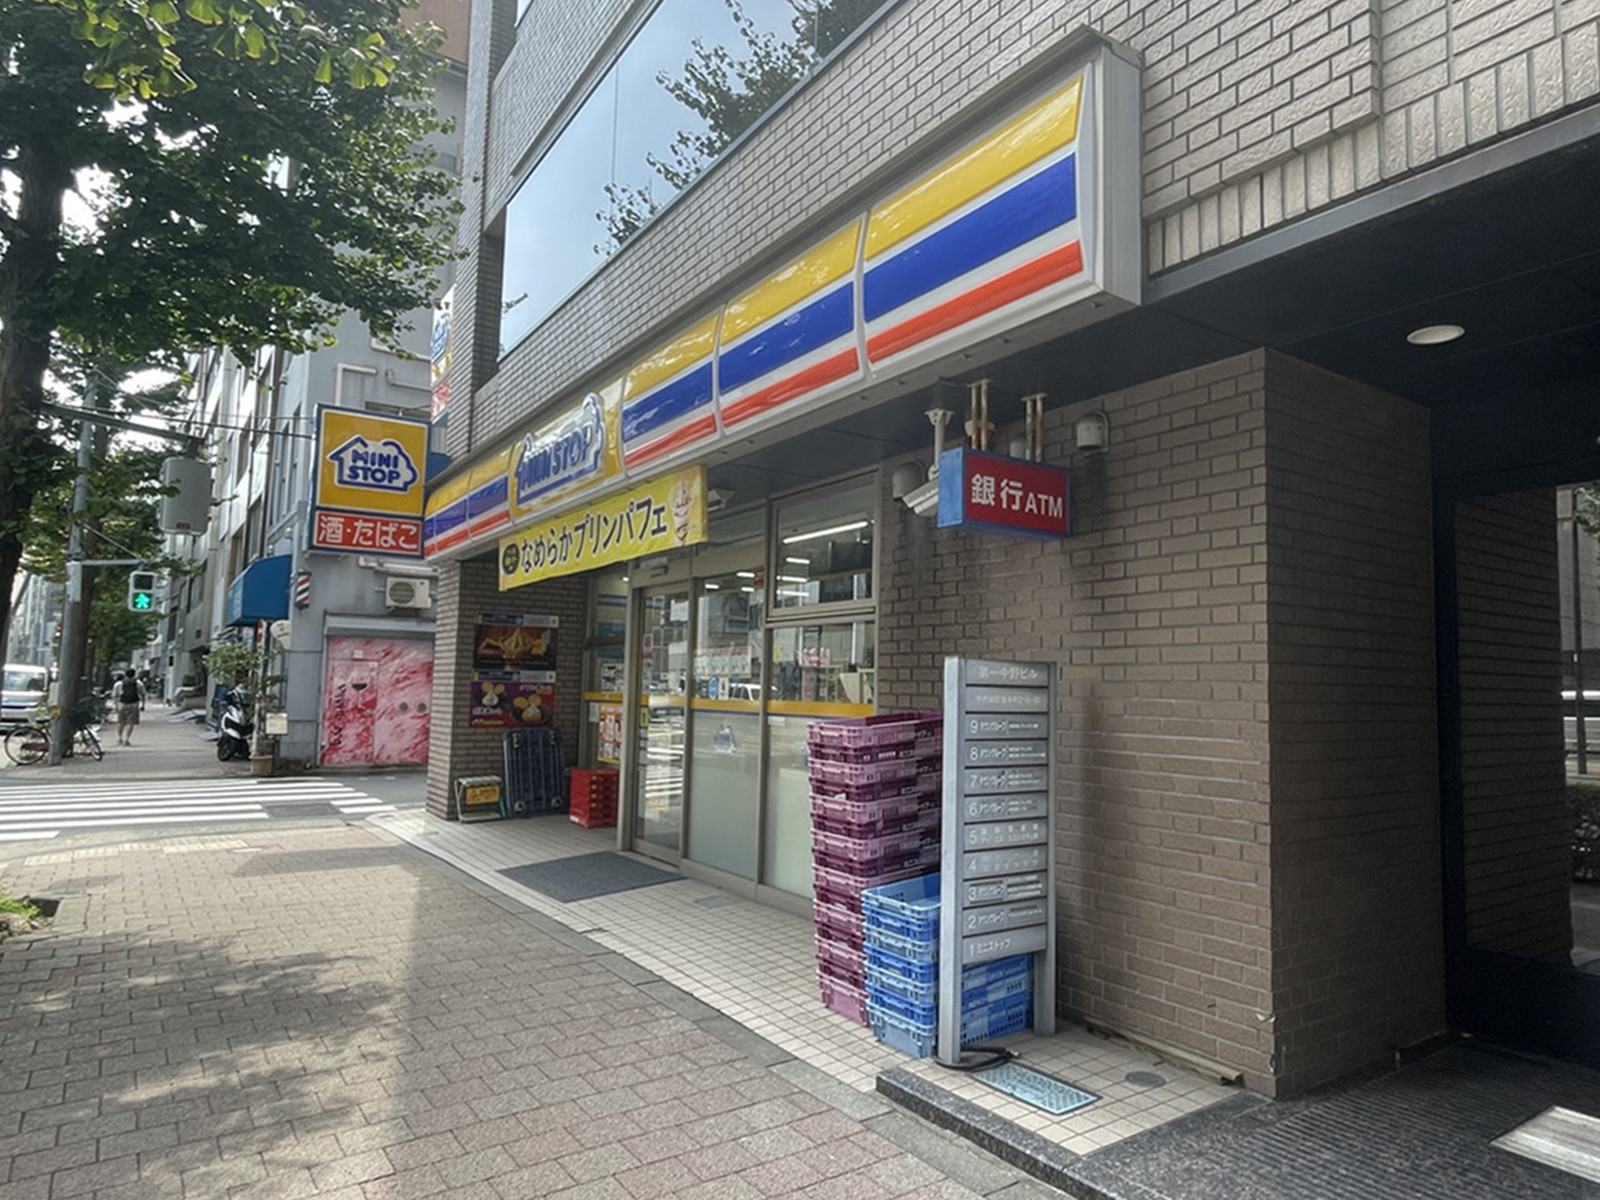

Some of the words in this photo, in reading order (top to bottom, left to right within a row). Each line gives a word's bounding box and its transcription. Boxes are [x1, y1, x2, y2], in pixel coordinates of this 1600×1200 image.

[551, 425, 593, 476] STOP
[351, 449, 399, 469] MINI
[347, 466, 401, 485] STOP
[970, 473, 1063, 519] 銀行ATM
[318, 515, 418, 549] 酒・たばこ
[520, 497, 669, 574] なめらかプリンパフェ
[970, 719, 978, 734] 9
[969, 747, 978, 761] 8
[969, 774, 978, 788] 7
[969, 802, 978, 816] 6
[969, 830, 978, 844] 5
[968, 857, 977, 871] 4
[968, 886, 977, 901] 3
[967, 915, 976, 929] 2
[969, 943, 974, 957] 1
